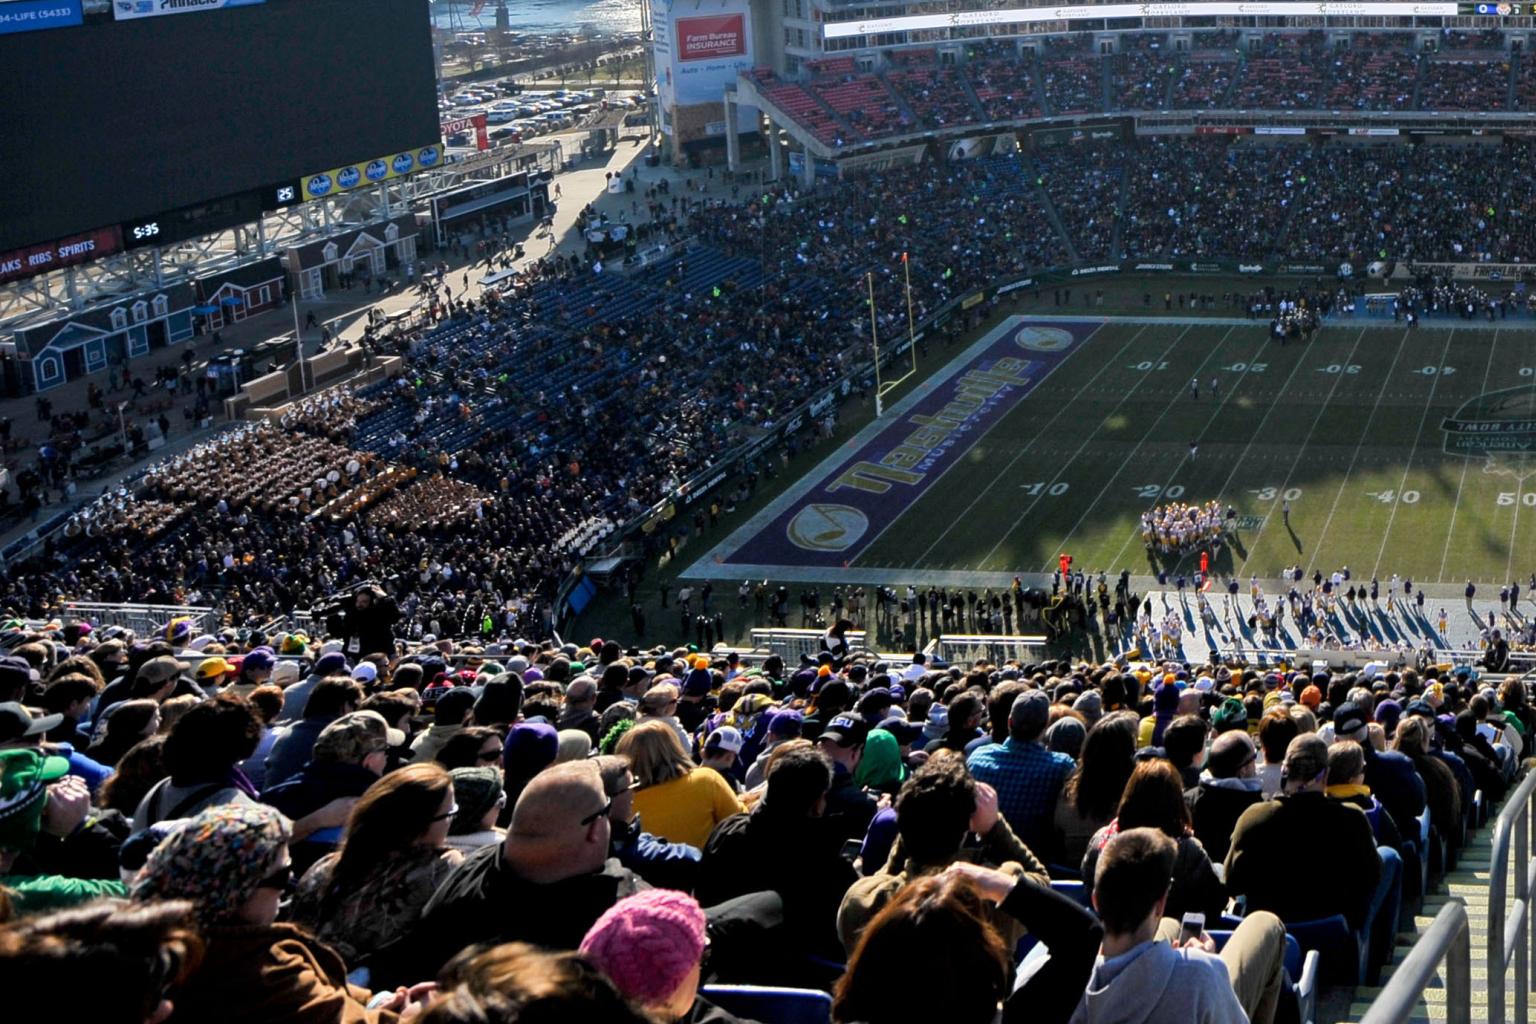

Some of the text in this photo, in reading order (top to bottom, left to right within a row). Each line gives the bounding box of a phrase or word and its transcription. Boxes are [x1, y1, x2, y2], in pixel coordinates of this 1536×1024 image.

[38, 8, 72, 19] (5433)
[686, 34, 709, 42] Farm
[686, 38, 737, 50] INSURANCE
[440, 118, 474, 135] OYOTA
[278, 187, 293, 201] 25
[133, 222, 160, 239] 5:35
[28, 251, 53, 267] RIBS
[58, 240, 96, 259] SPIRITS
[1456, 422, 1498, 432] BOWL
[1029, 483, 1070, 497] 10
[1141, 484, 1186, 499] 20
[1257, 487, 1303, 502] 30
[1377, 489, 1422, 505] 40
[827, 717, 855, 728] LSU
